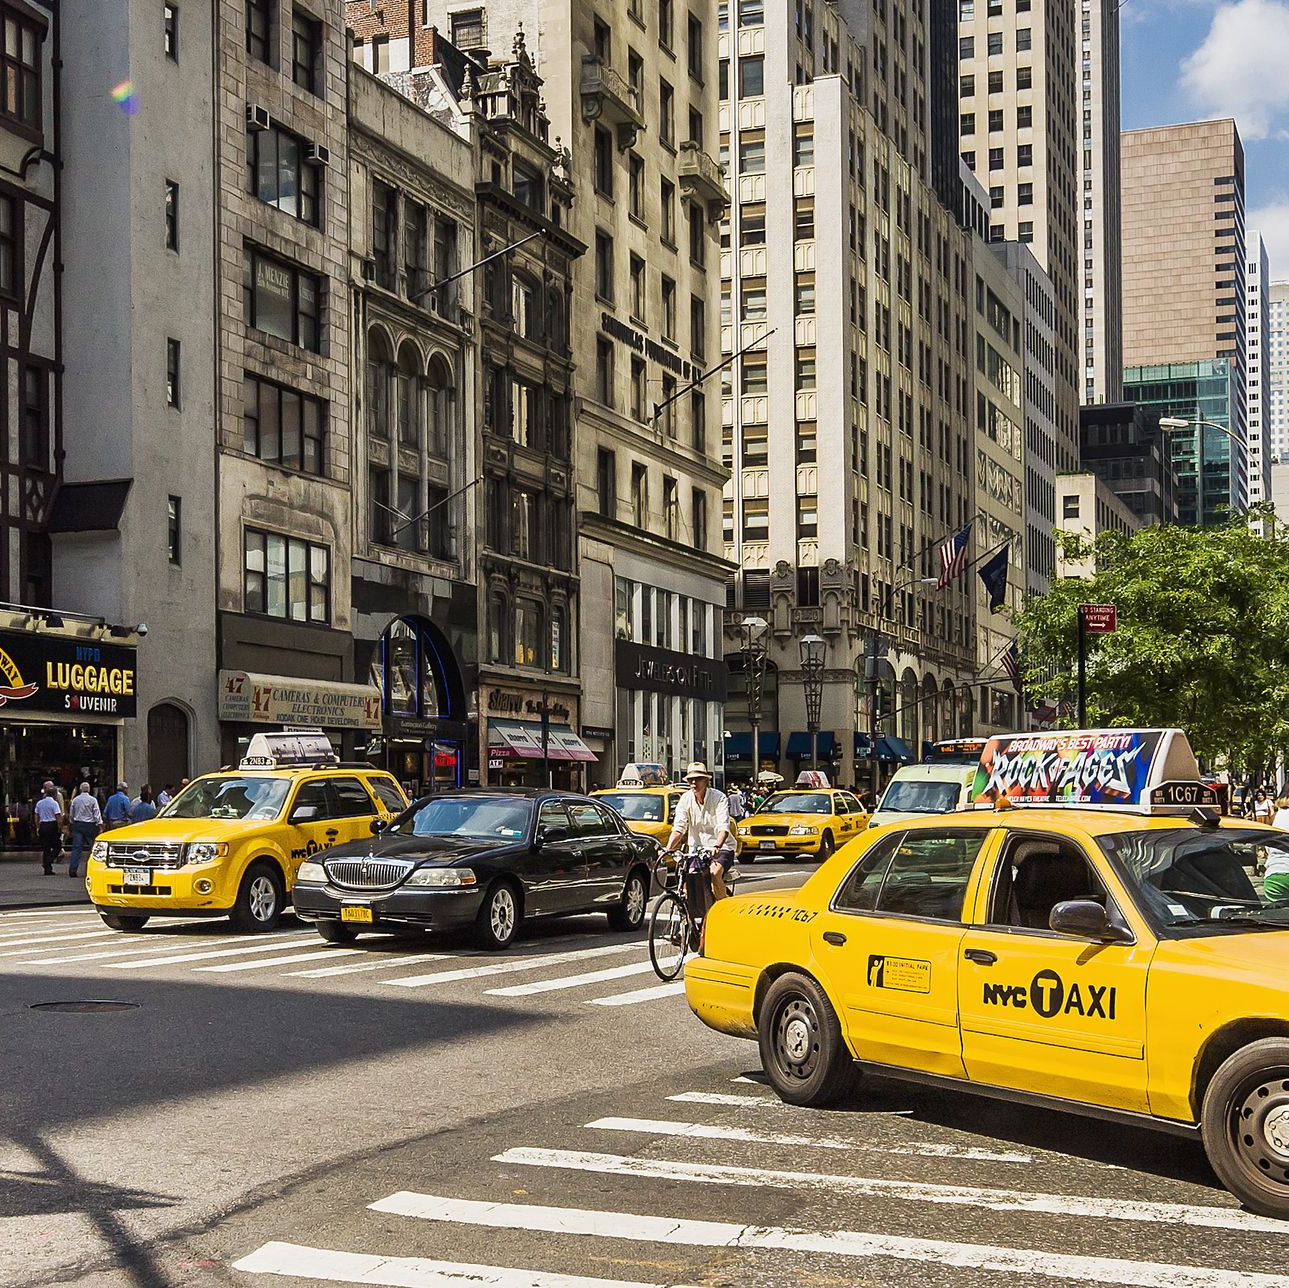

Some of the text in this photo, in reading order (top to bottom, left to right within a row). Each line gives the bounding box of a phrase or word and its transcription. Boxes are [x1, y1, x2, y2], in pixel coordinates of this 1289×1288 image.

[46, 661, 134, 696] LUGGAGE
[225, 677, 245, 693] 47
[252, 686, 272, 711] 47
[273, 689, 366, 708] CAMERAS & COMPUTERS
[291, 703, 345, 716] ELECTRONICS
[364, 696, 380, 719] 47
[276, 713, 295, 722] KODAK
[297, 715, 309, 723] ONE
[310, 716, 326, 725] HOUR
[327, 717, 360, 726] DEVELOPING
[1008, 735, 1132, 752] BROADWAY'S BEST PARTY!
[249, 757, 265, 765] 2N83
[490, 749, 510, 757] Pizza
[489, 760, 503, 768] ATM
[982, 748, 1057, 796] ROCK
[1059, 742, 1147, 798] AGES
[1168, 786, 1198, 802] 1C67
[290, 848, 307, 859] NYC
[791, 908, 818, 925] 1C67
[983, 970, 1117, 1020] NYC TAXI
